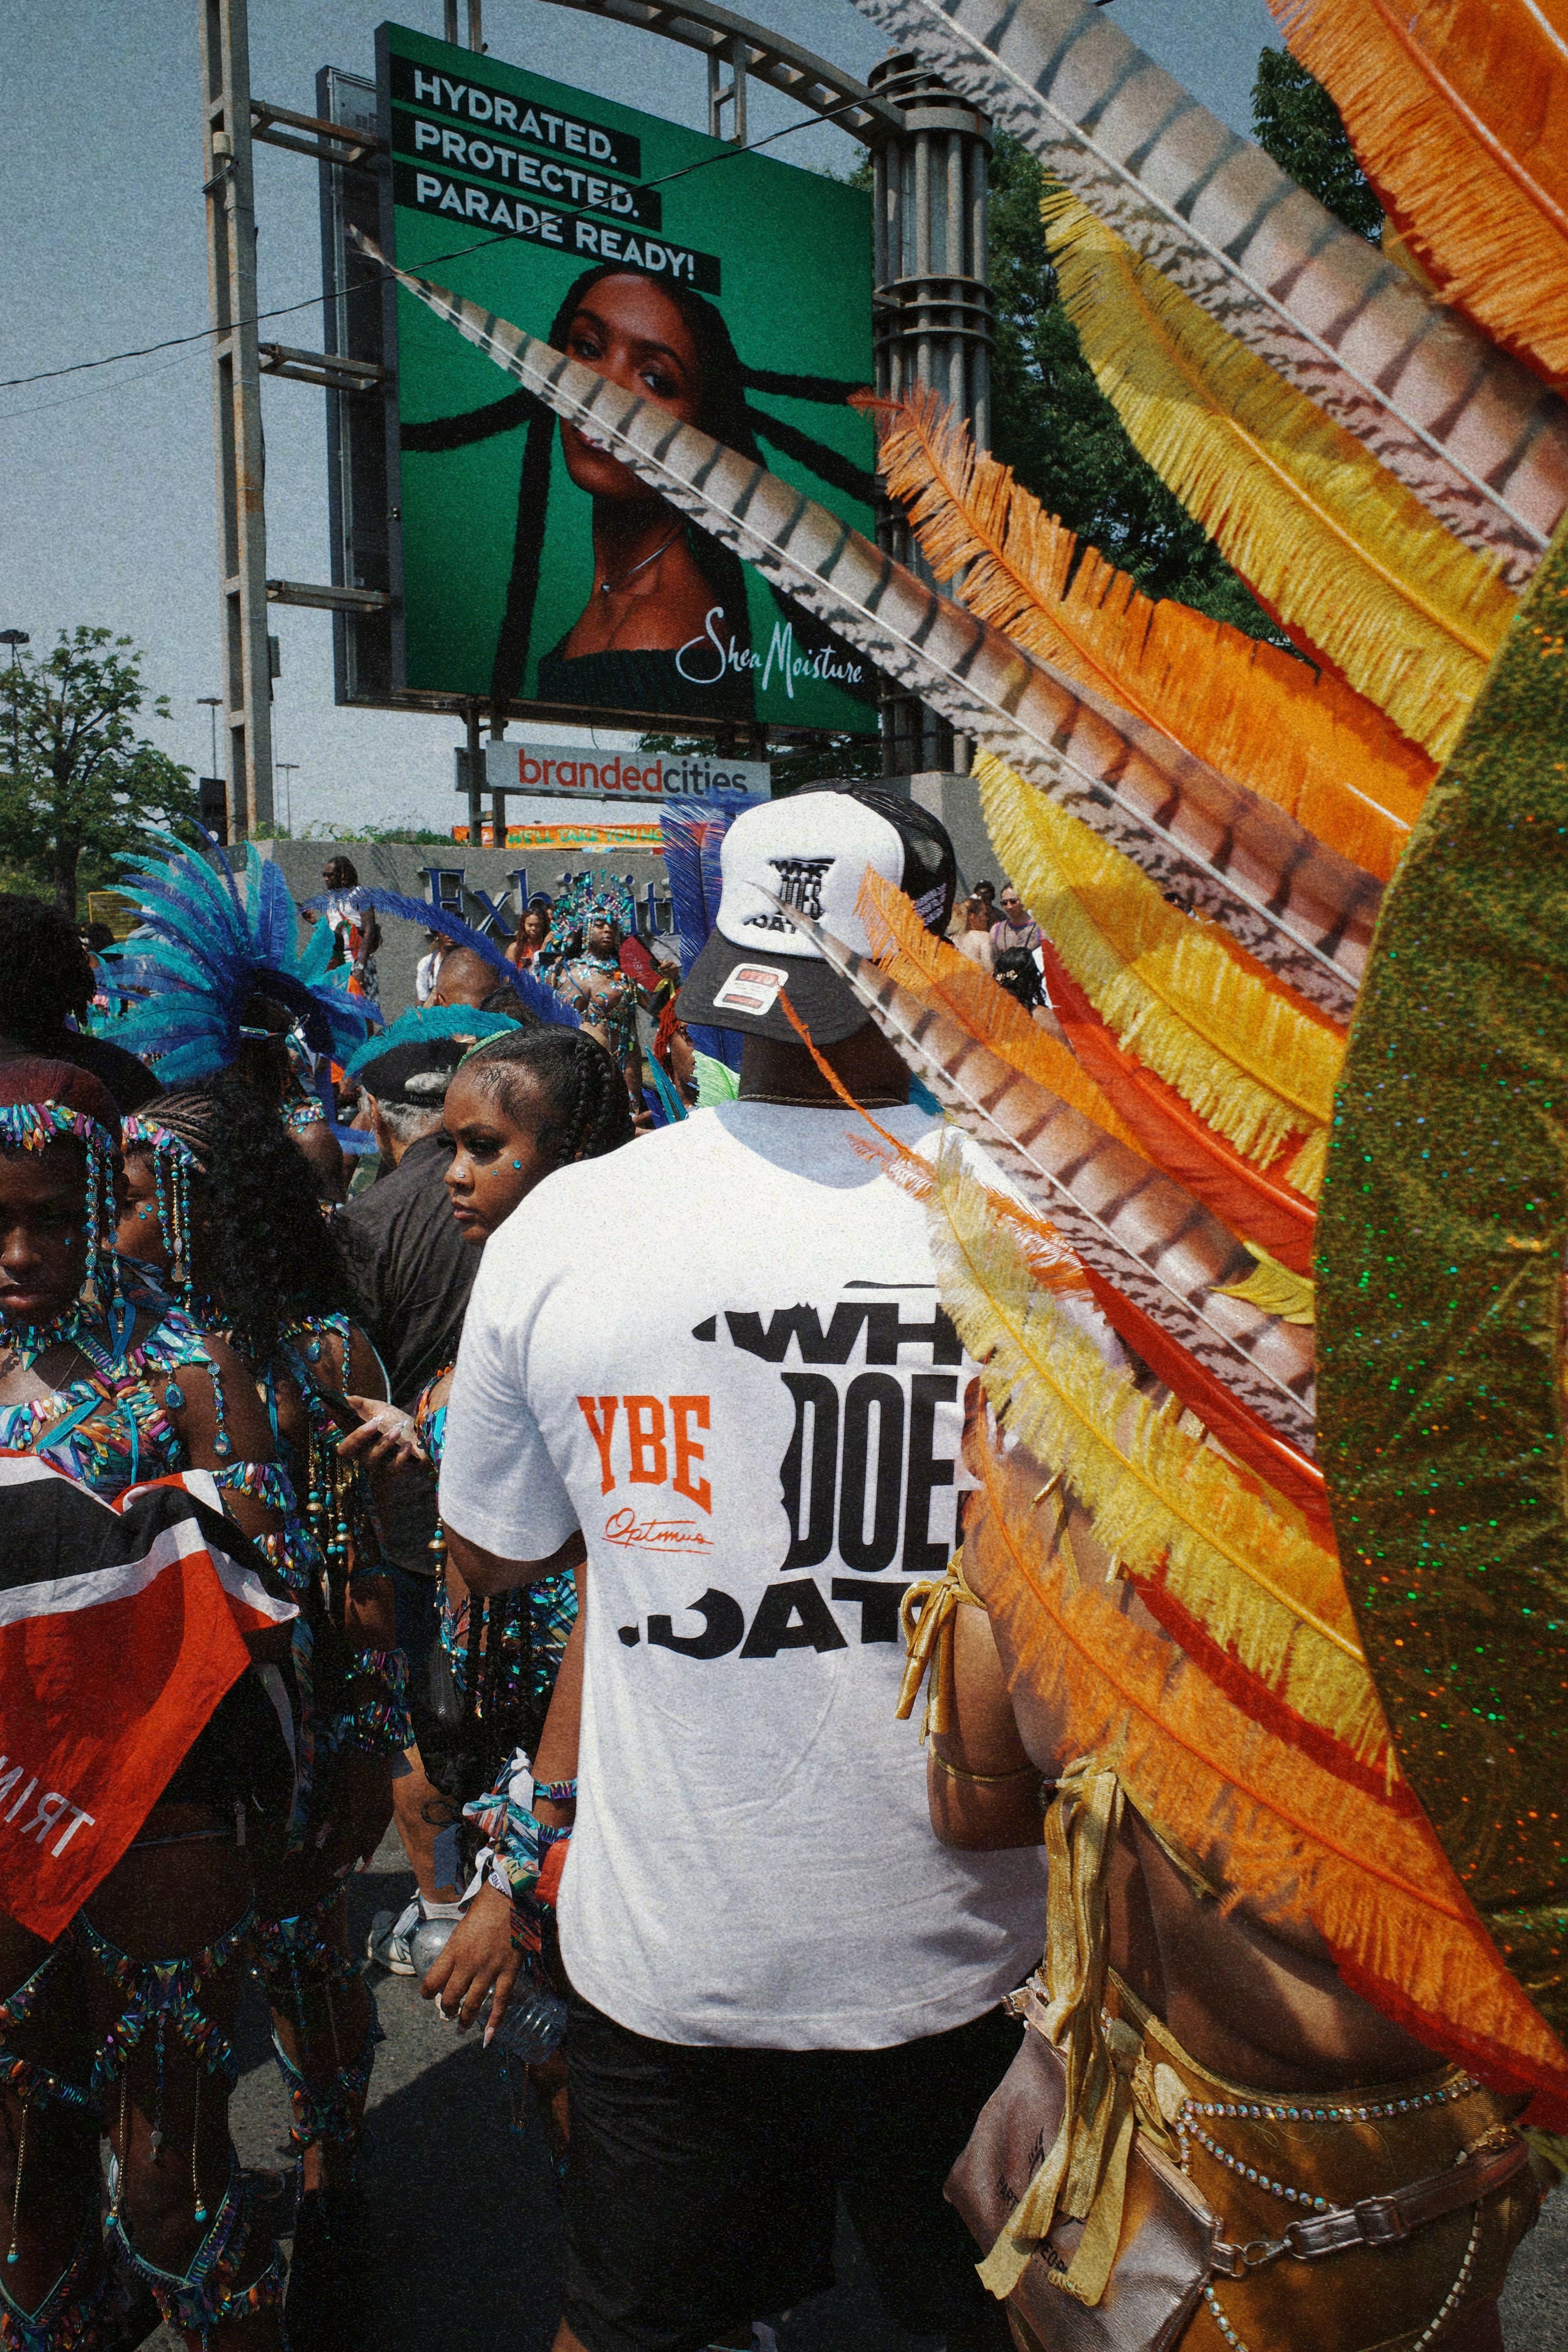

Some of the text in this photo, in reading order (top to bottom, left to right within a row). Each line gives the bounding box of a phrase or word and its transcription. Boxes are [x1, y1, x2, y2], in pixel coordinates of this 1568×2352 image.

[414, 69, 617, 164] HYDRATED.
[414, 120, 640, 218] PROTECTED.
[416, 173, 695, 281] PARADE READY!
[506, 829, 555, 844] WE'LL
[557, 828, 598, 842] TAKE
[603, 828, 637, 842] YOU
[577, 1395, 712, 1515] YBE
[491, 1873, 506, 1894] AND
